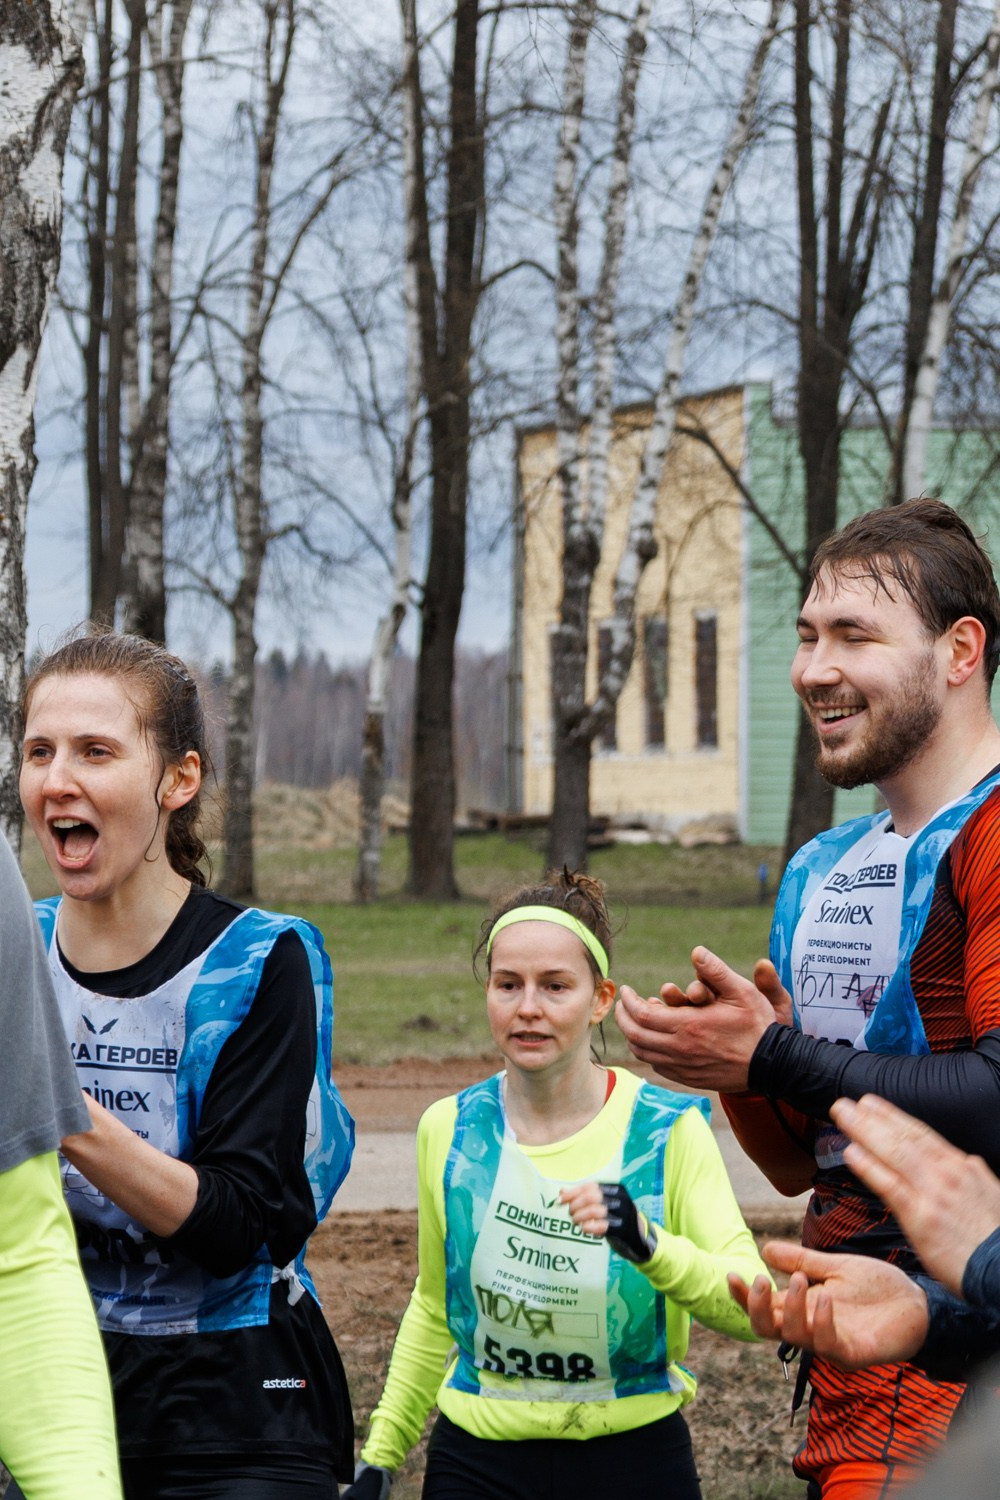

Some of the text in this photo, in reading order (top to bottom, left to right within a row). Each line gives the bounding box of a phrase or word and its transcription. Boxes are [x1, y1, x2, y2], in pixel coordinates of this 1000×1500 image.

[854, 864, 897, 882] ГЕРОЕВ
[817, 954, 872, 966] DEVELOPMENT
[96, 1044, 178, 1066] ГЕРОЕВ
[492, 1281, 578, 1306] FINE DEVELOPMENT
[482, 1334, 597, 1380] 5398
[263, 1378, 306, 1389] astetica
